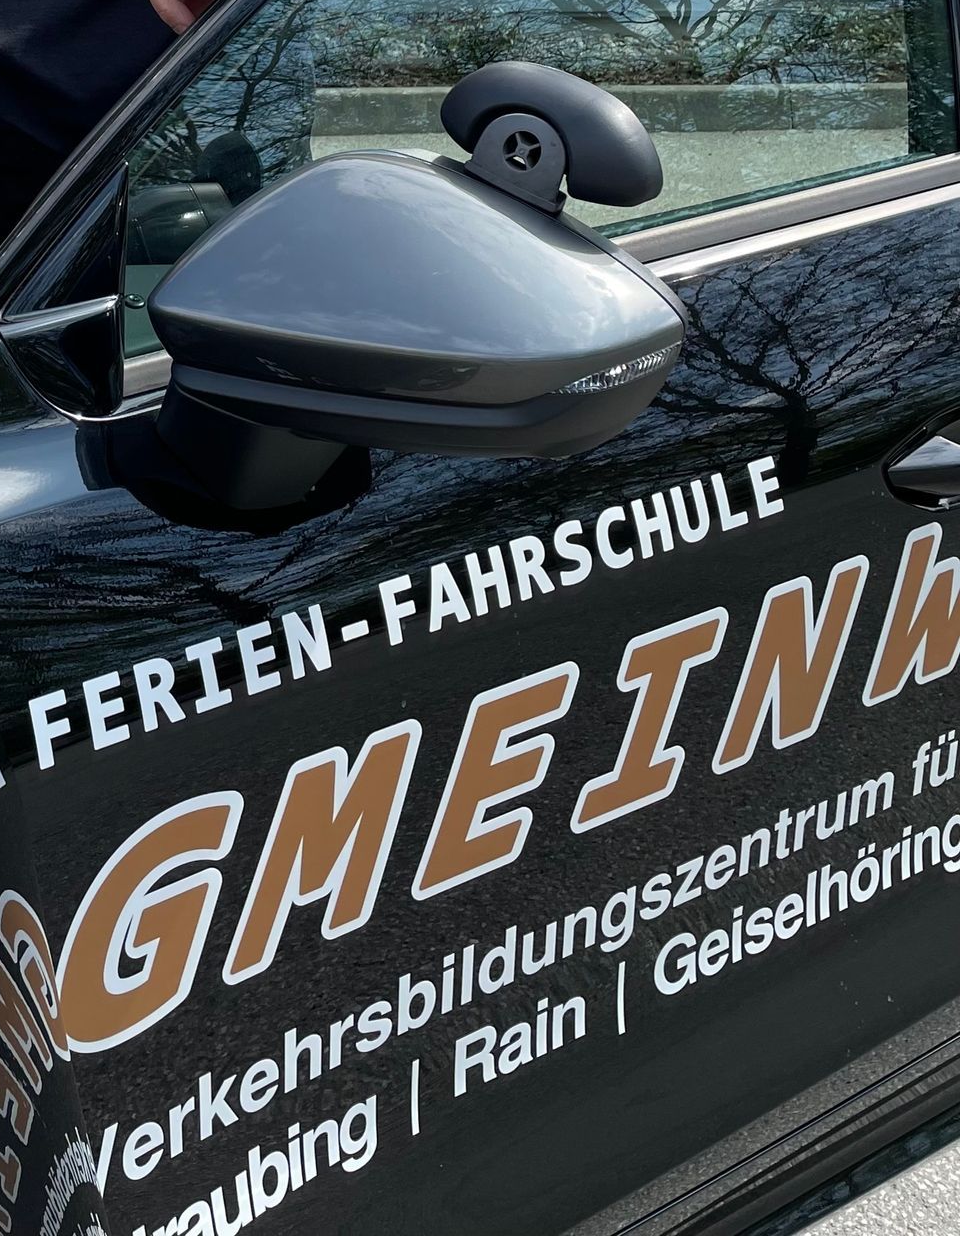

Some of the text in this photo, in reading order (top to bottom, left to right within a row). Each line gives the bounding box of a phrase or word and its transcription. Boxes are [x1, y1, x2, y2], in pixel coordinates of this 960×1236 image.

[27, 455, 785, 770] FERIEN-FAHRSCHULE
[453, 995, 587, 1097] Rain
[653, 814, 960, 996] Geiselhöring
